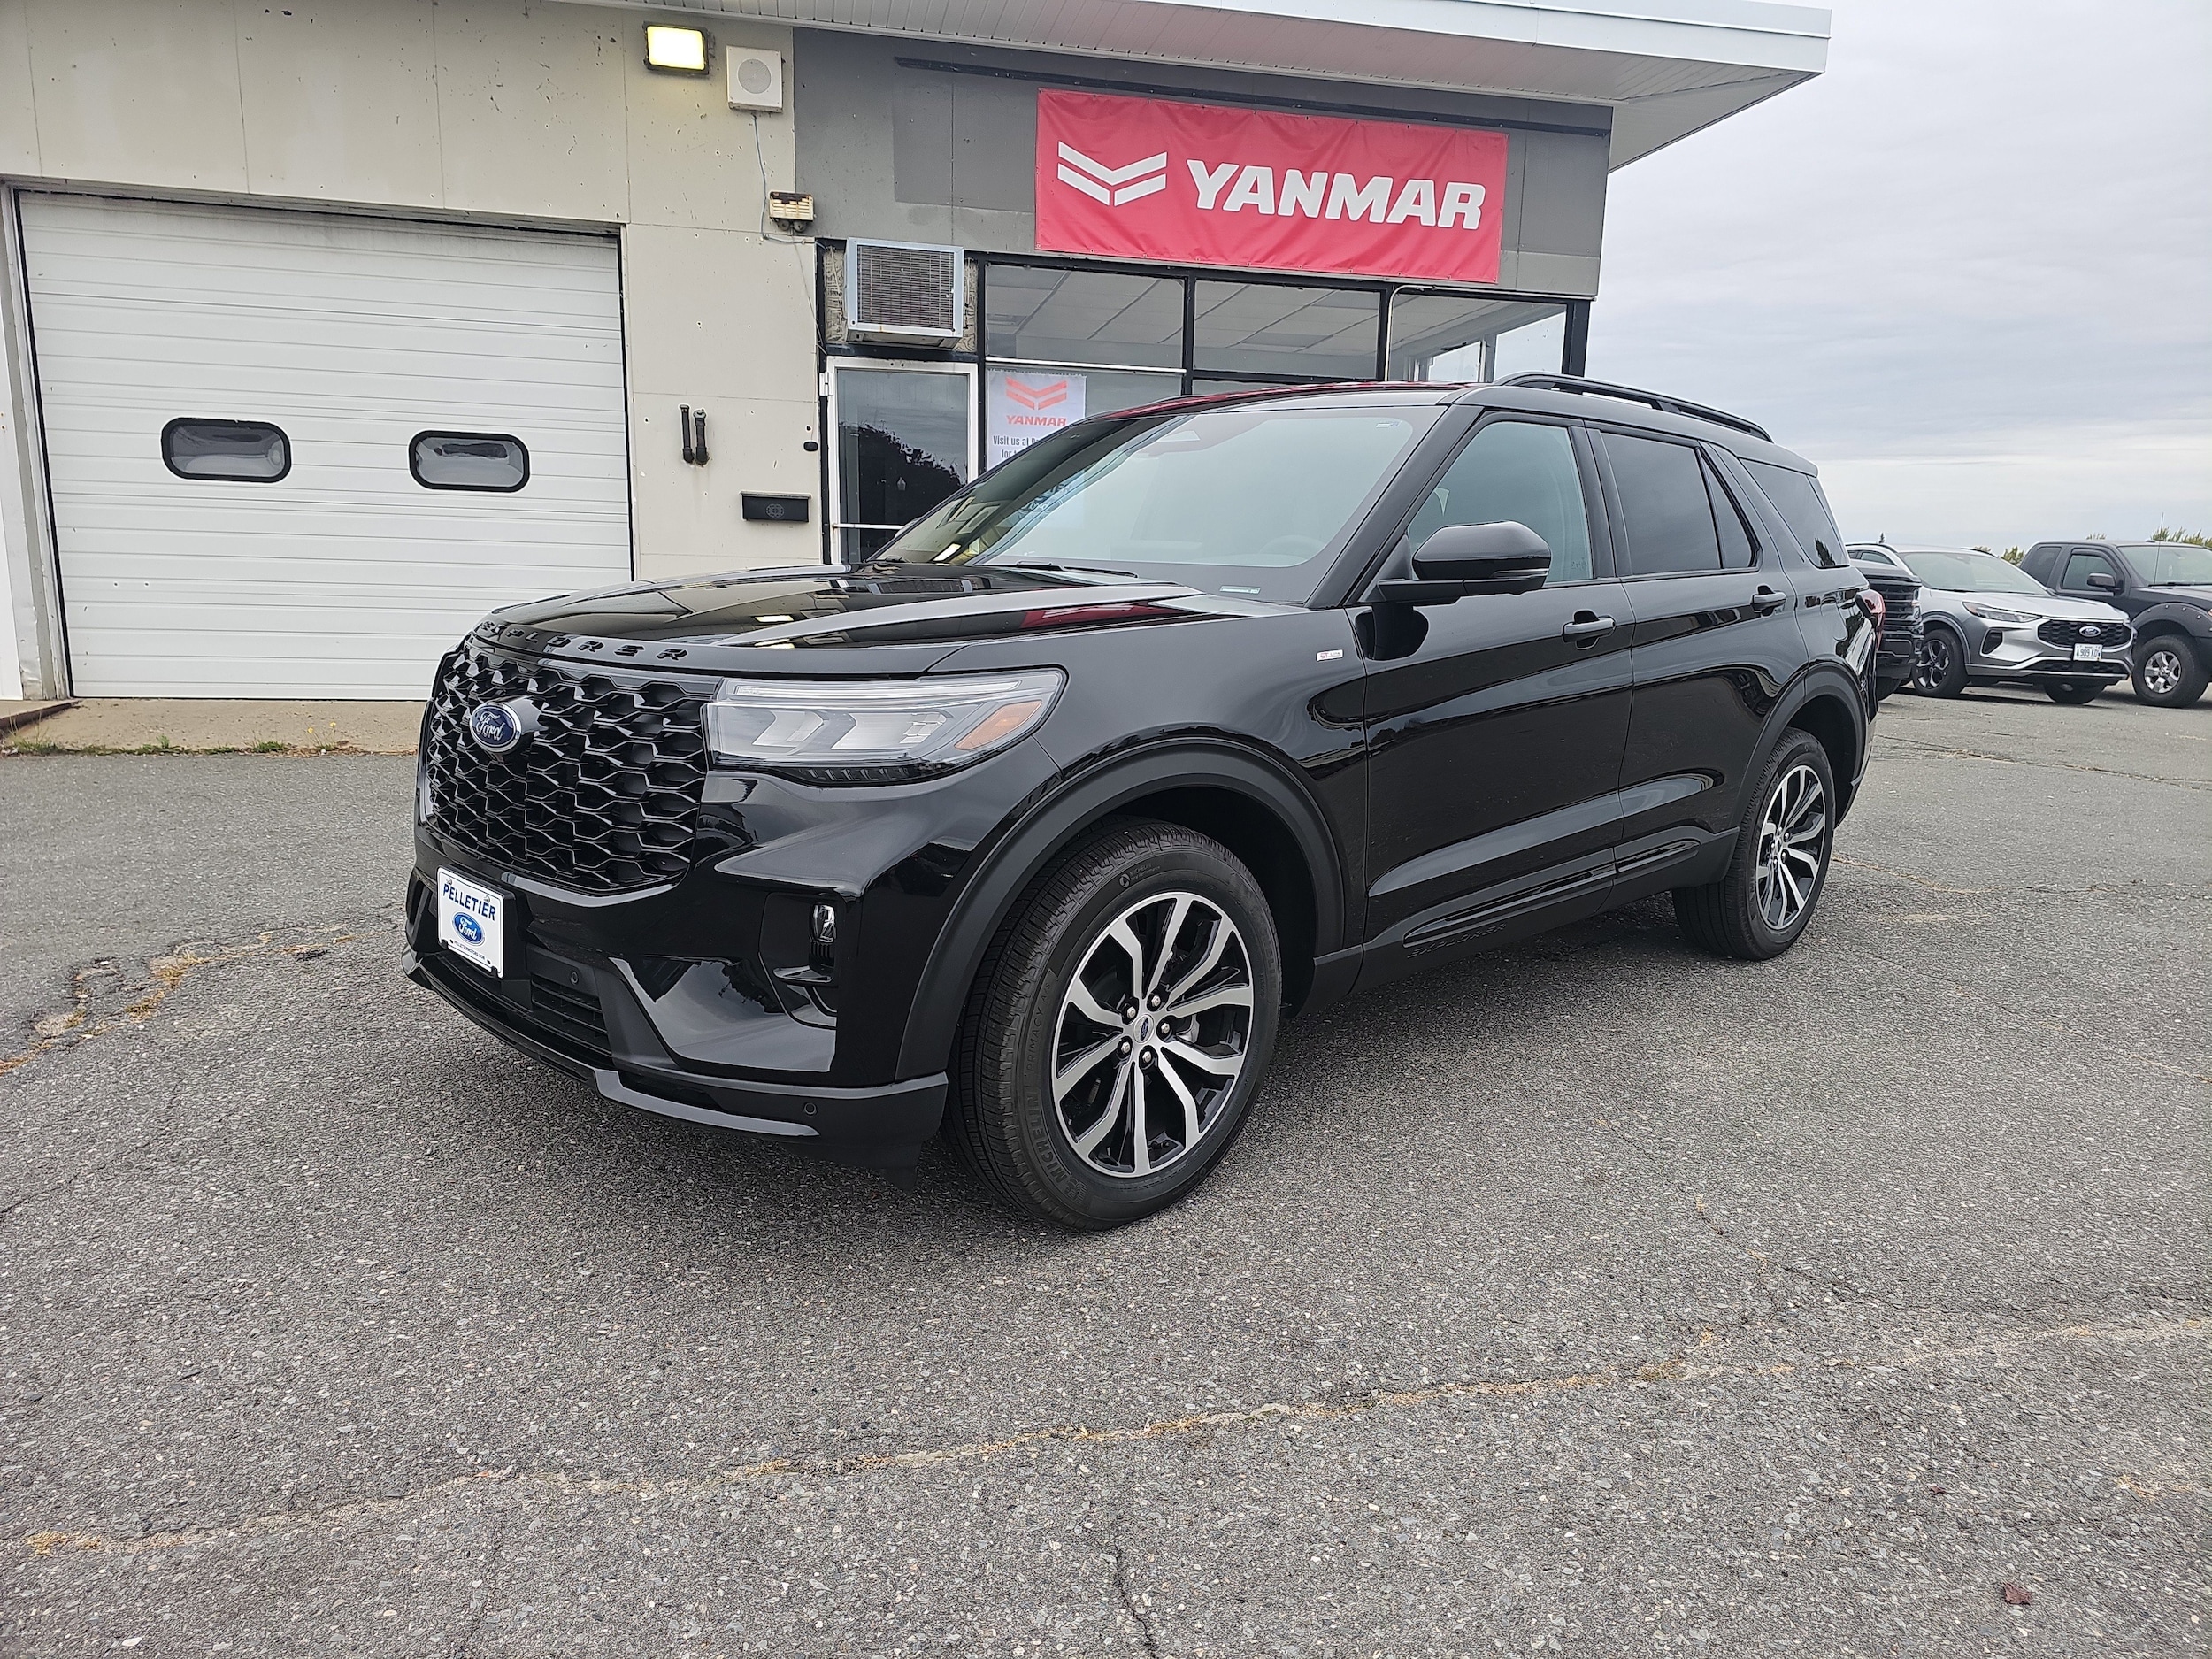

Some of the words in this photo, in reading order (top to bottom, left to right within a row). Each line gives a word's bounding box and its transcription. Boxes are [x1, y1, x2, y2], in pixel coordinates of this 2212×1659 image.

[1187, 158, 1486, 230] YANMAR
[1006, 415, 1066, 426] YANMAR
[993, 435, 1009, 445] Visit
[1010, 437, 1020, 446] us
[1021, 436, 1029, 446] at
[481, 620, 688, 661] EXPLORER
[475, 711, 505, 741] Ford
[443, 883, 496, 921] PELLETIER
[459, 916, 479, 941] Ford
[1025, 1007, 1044, 1072] PRIMACY
[1025, 1087, 1069, 1184] MICHELIN
